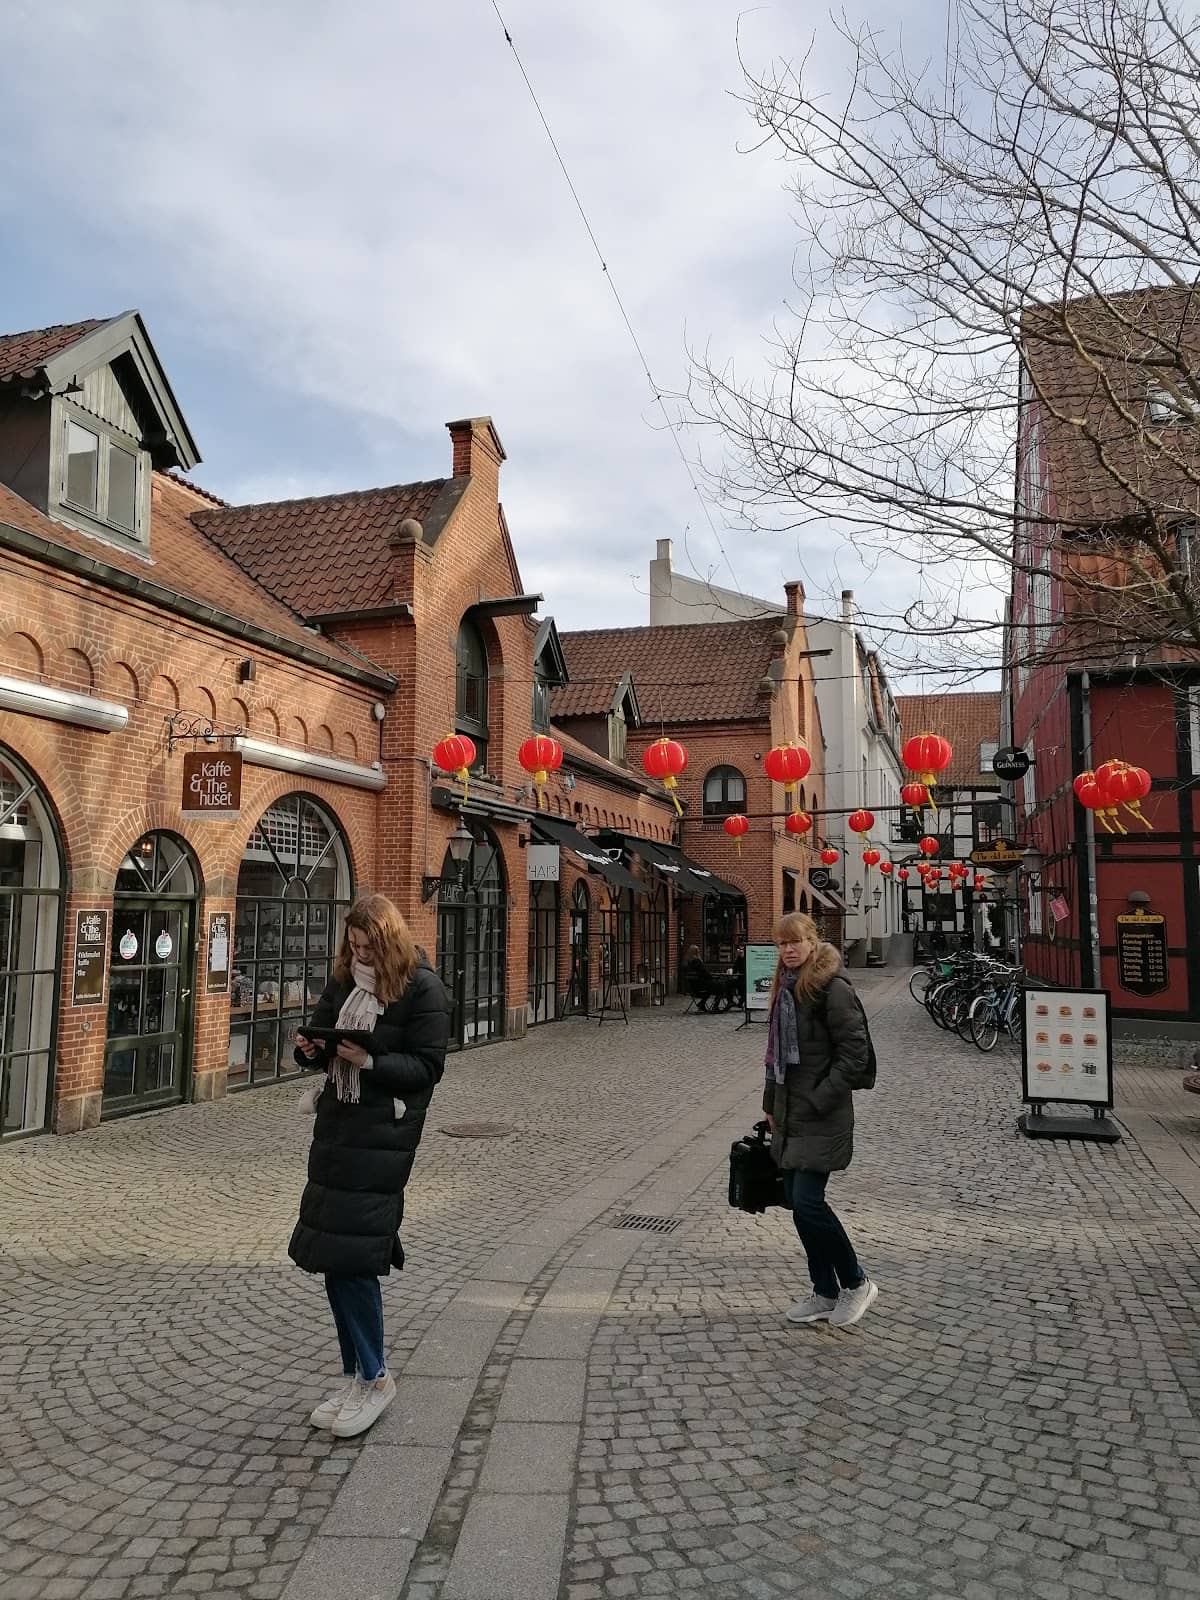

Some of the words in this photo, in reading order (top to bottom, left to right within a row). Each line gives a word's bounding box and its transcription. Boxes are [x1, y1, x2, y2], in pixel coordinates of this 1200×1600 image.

[201, 760, 232, 777] Kaffe
[997, 761, 1026, 769] GUINNESS
[190, 773, 202, 792] &
[206, 777, 228, 794] The
[199, 789, 232, 806] huset
[976, 852, 987, 860] The
[528, 864, 557, 879] HAIR
